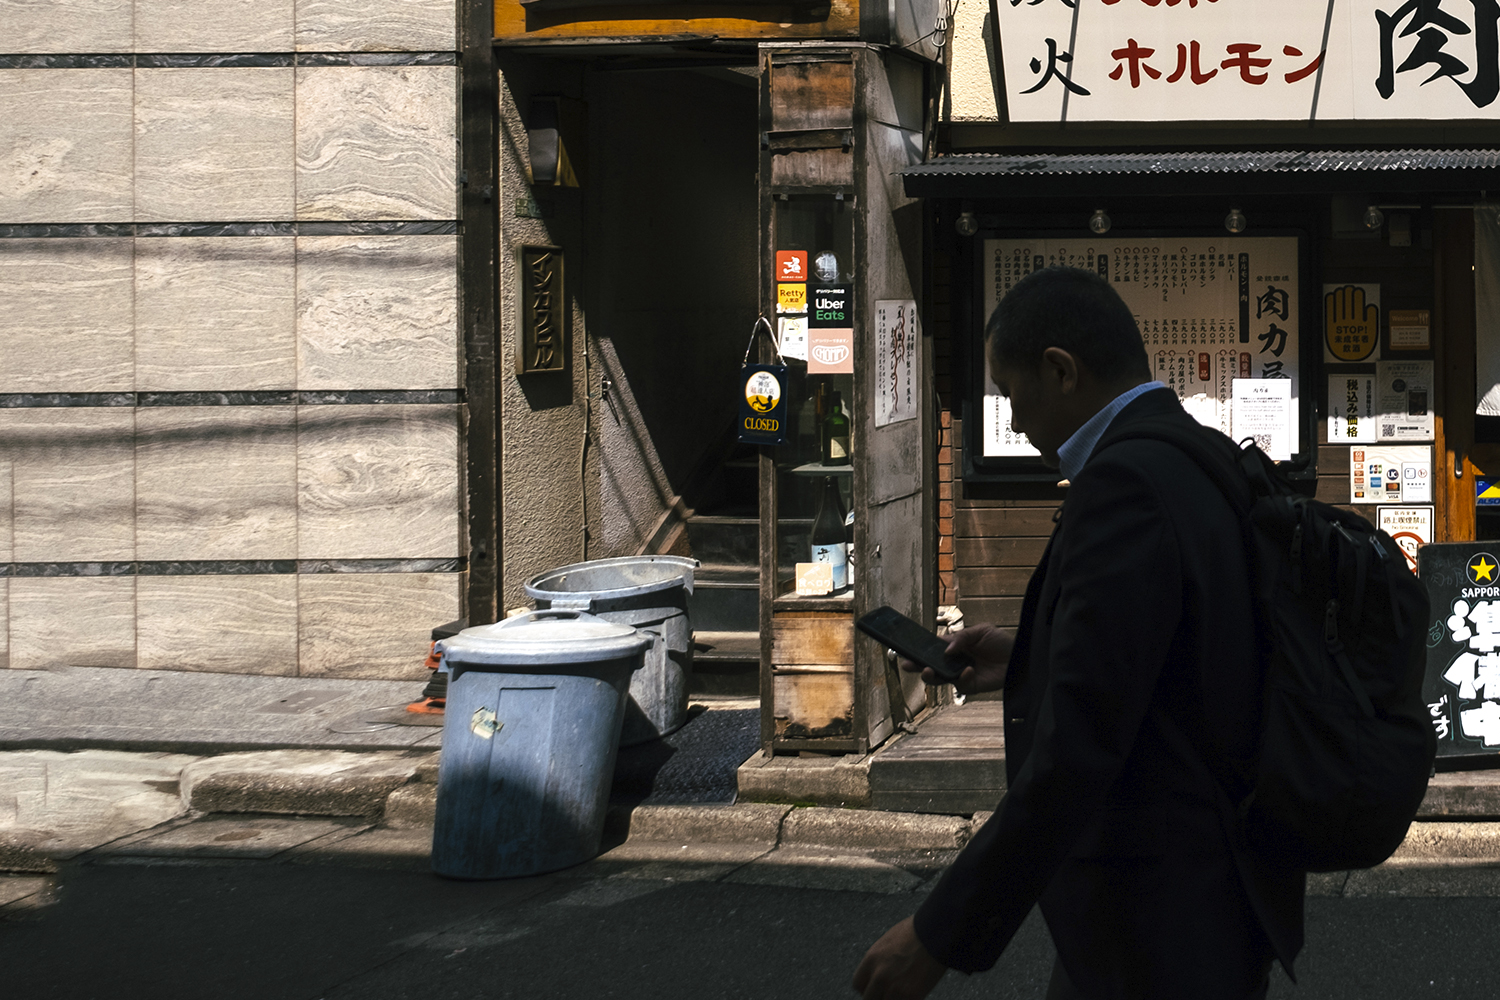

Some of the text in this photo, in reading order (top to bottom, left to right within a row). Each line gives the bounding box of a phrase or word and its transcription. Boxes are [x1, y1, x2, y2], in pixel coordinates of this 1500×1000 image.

[1108, 39, 1327, 90] ホルモン
[780, 289, 805, 299] Retty
[816, 298, 845, 310] Uber
[531, 251, 555, 369] イシカワビル
[816, 310, 845, 321] Eats
[1336, 325, 1368, 334] STOP!
[1334, 335, 1369, 344] 未成年者
[1343, 344, 1361, 353] 飲酒
[1347, 379, 1359, 438] 税込み価格
[744, 416, 780, 432] CLOSED
[1383, 516, 1427, 524] 路上喫煙禁止
[1427, 694, 1451, 740] です
